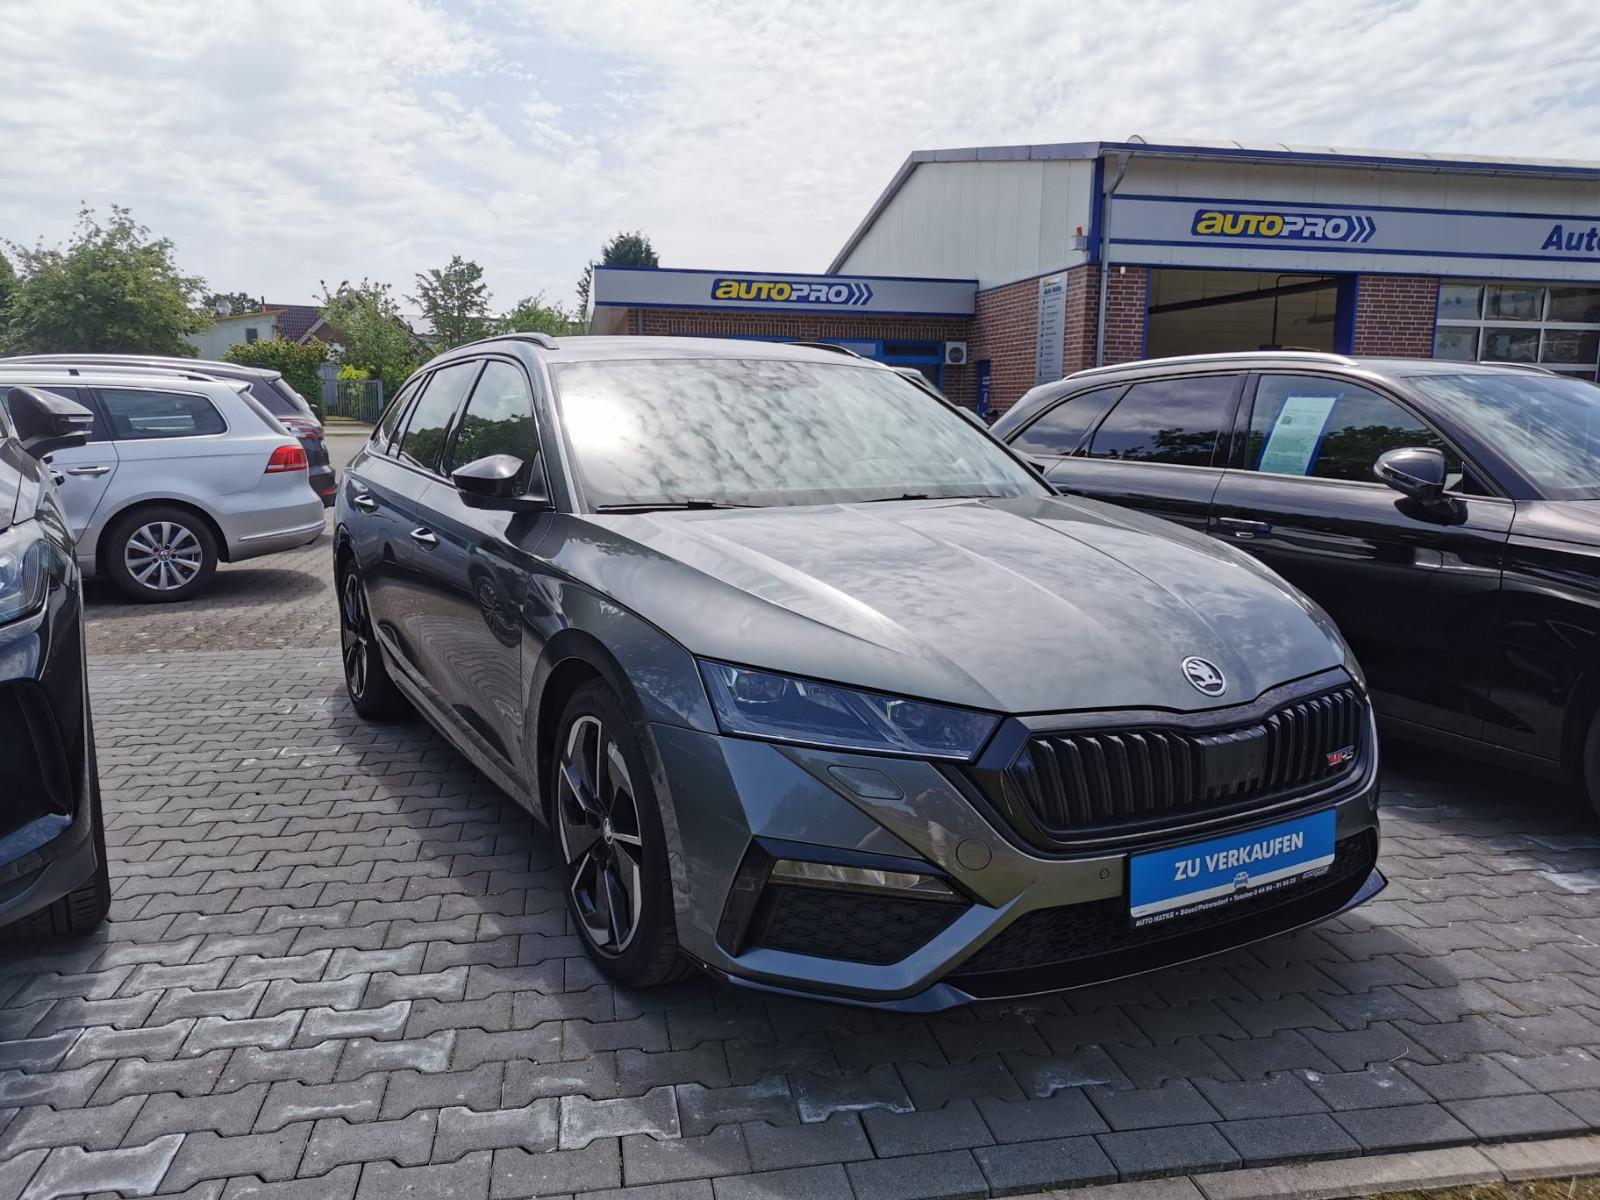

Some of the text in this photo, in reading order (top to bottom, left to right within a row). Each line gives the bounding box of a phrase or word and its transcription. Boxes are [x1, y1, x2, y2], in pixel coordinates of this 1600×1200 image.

[1540, 223, 1600, 252] Aut
[1173, 831, 1304, 881] ZU VERKAUFEN
[1135, 916, 1153, 927] AUTO
